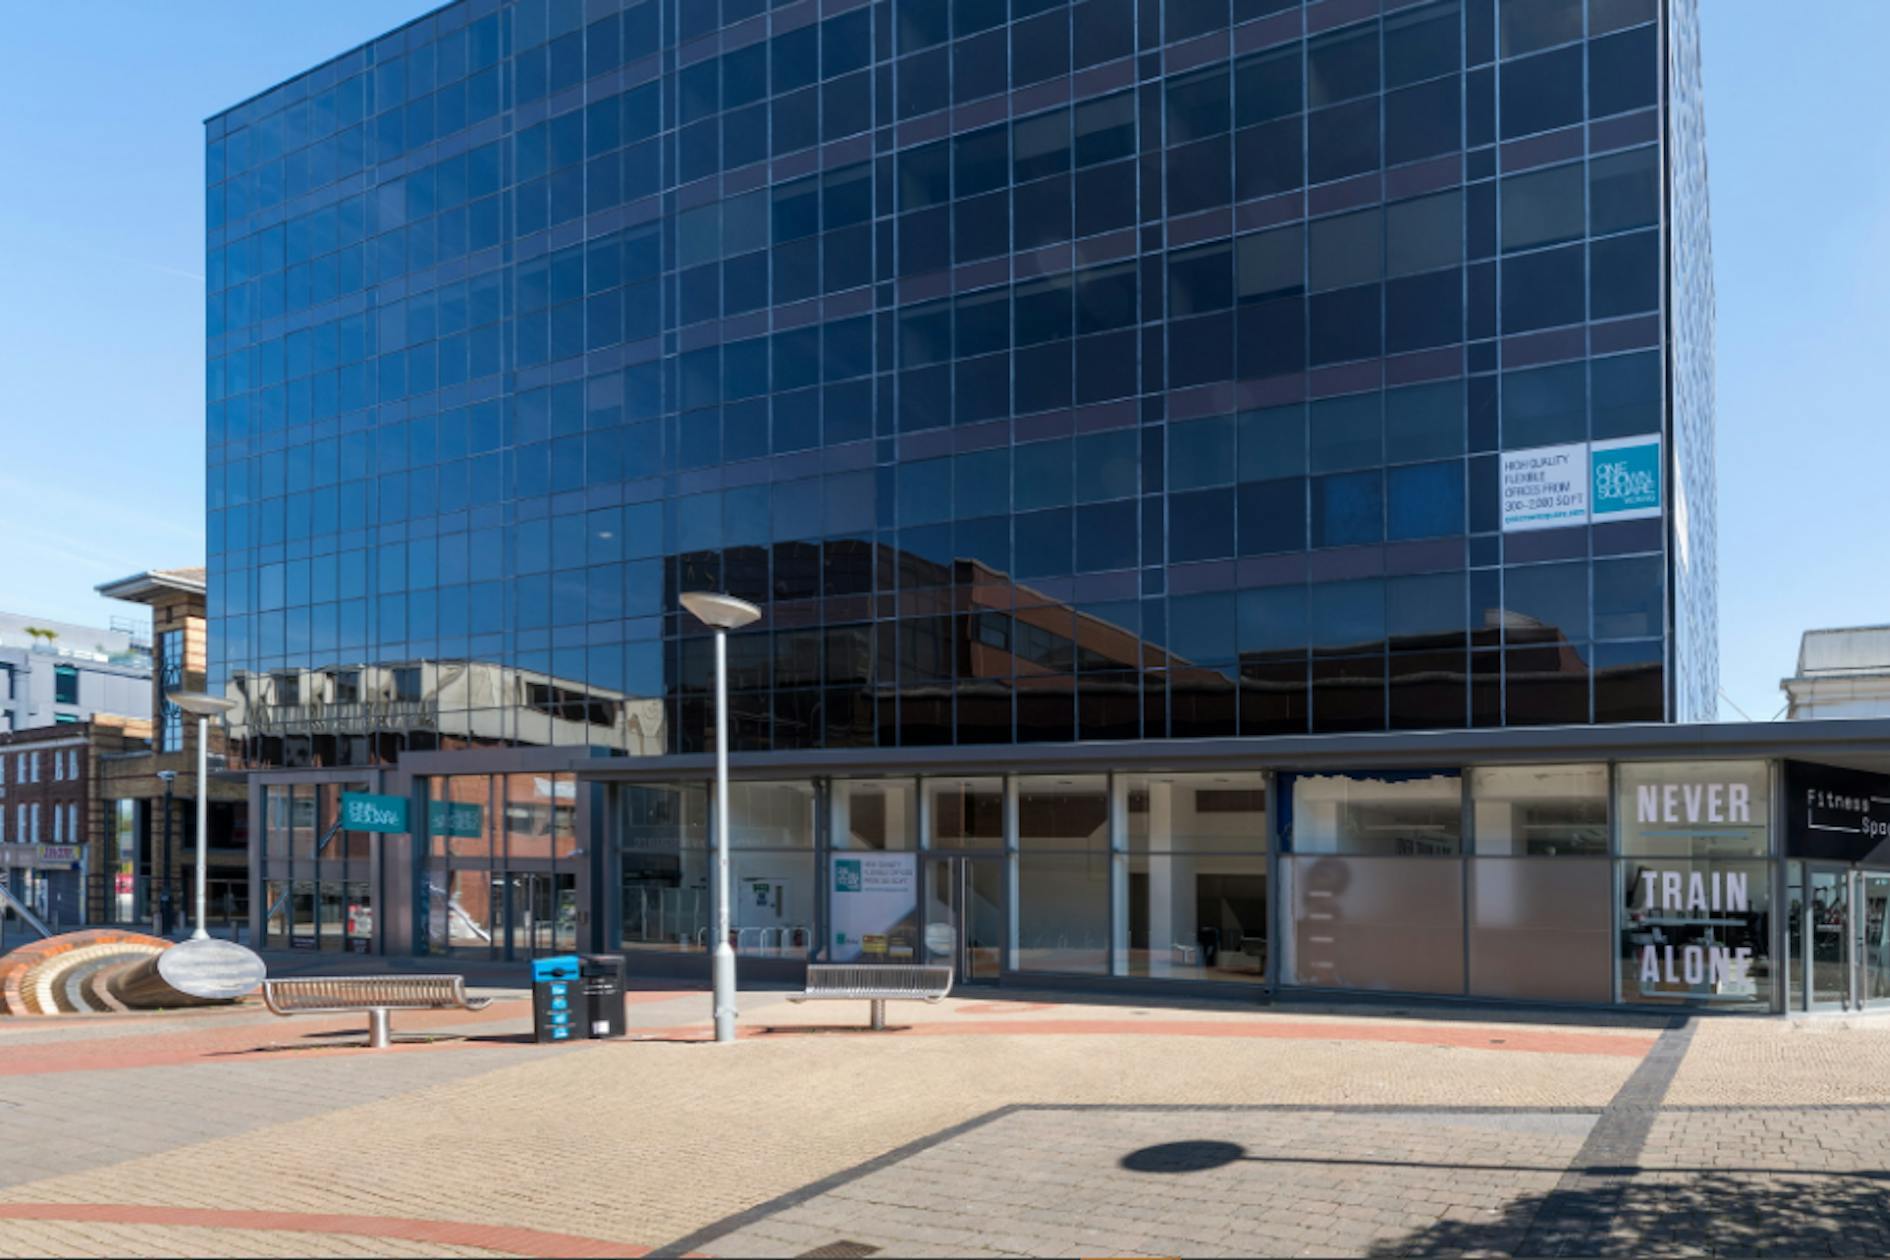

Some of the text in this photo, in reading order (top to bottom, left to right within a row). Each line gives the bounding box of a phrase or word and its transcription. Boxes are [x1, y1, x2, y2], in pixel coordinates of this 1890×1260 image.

[1637, 783, 1750, 823] NEVER
[1807, 788, 1870, 813] Fitness
[1641, 871, 1749, 911] TRAIN
[1640, 945, 1754, 985] ALONE
